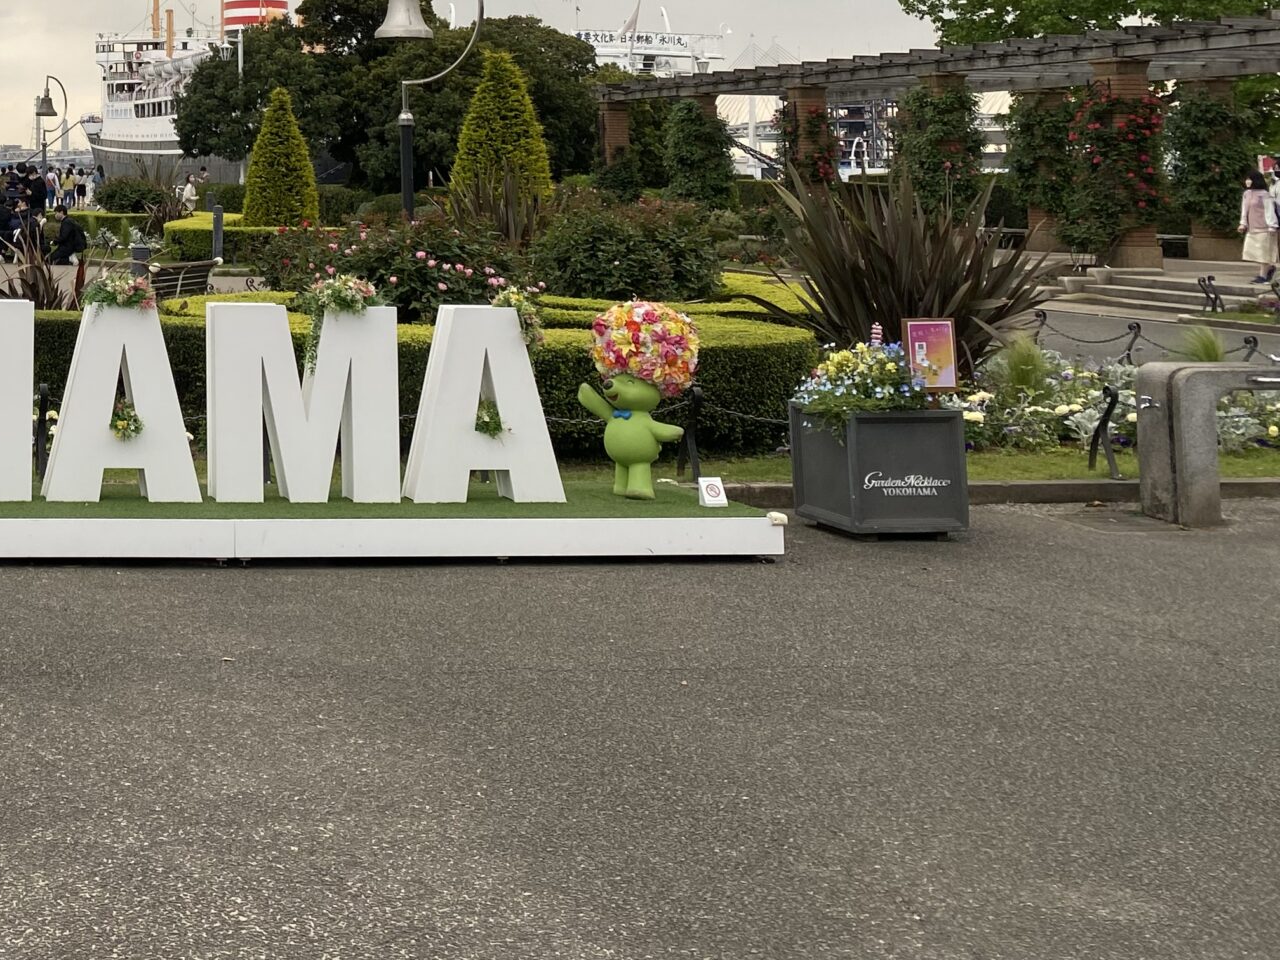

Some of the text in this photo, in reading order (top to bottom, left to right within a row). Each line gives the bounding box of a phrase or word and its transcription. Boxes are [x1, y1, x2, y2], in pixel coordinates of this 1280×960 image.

[863, 471, 951, 490] Garden Necklace
[882, 487, 938, 497] YOKOHAMA
